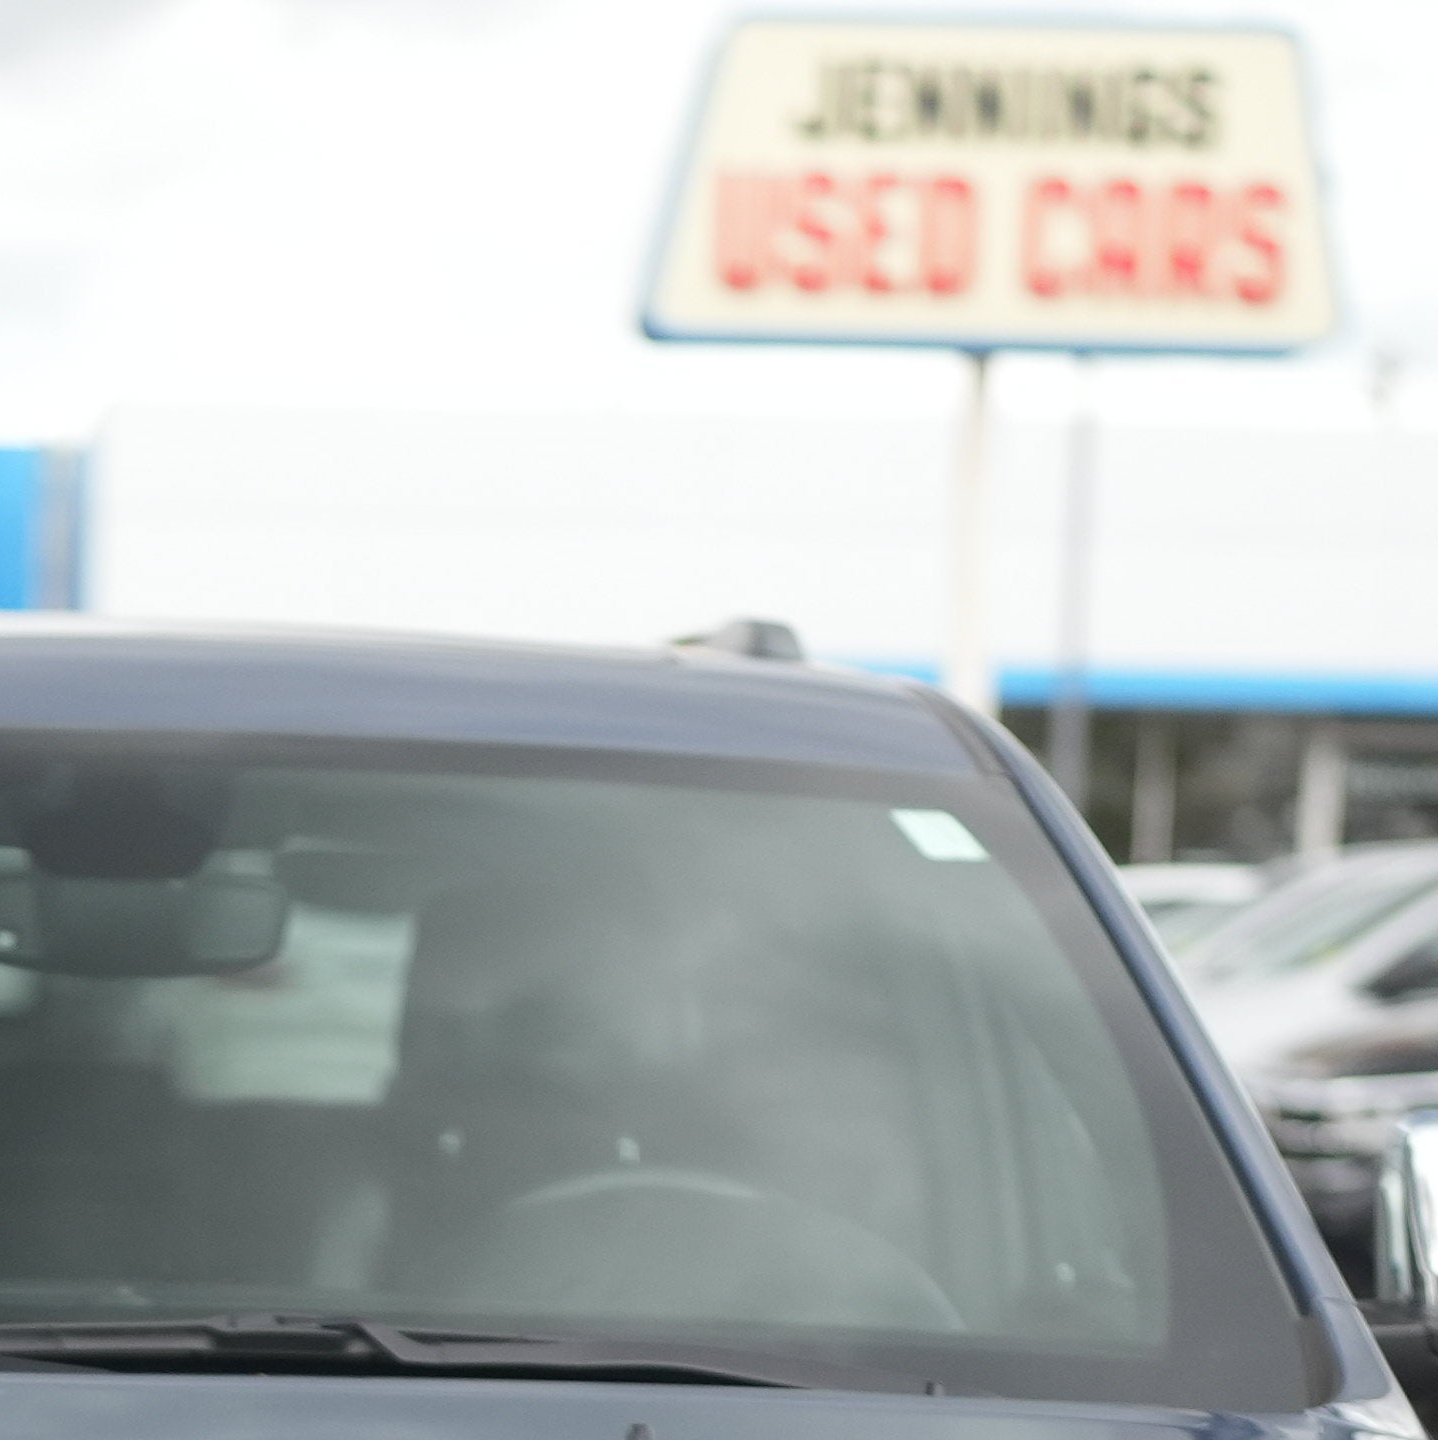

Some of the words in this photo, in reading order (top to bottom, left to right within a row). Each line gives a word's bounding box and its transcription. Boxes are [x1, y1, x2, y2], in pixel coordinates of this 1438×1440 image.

[794, 60, 1220, 149] JENNINGS
[714, 172, 980, 295] USED
[1022, 176, 1287, 306] CARS
